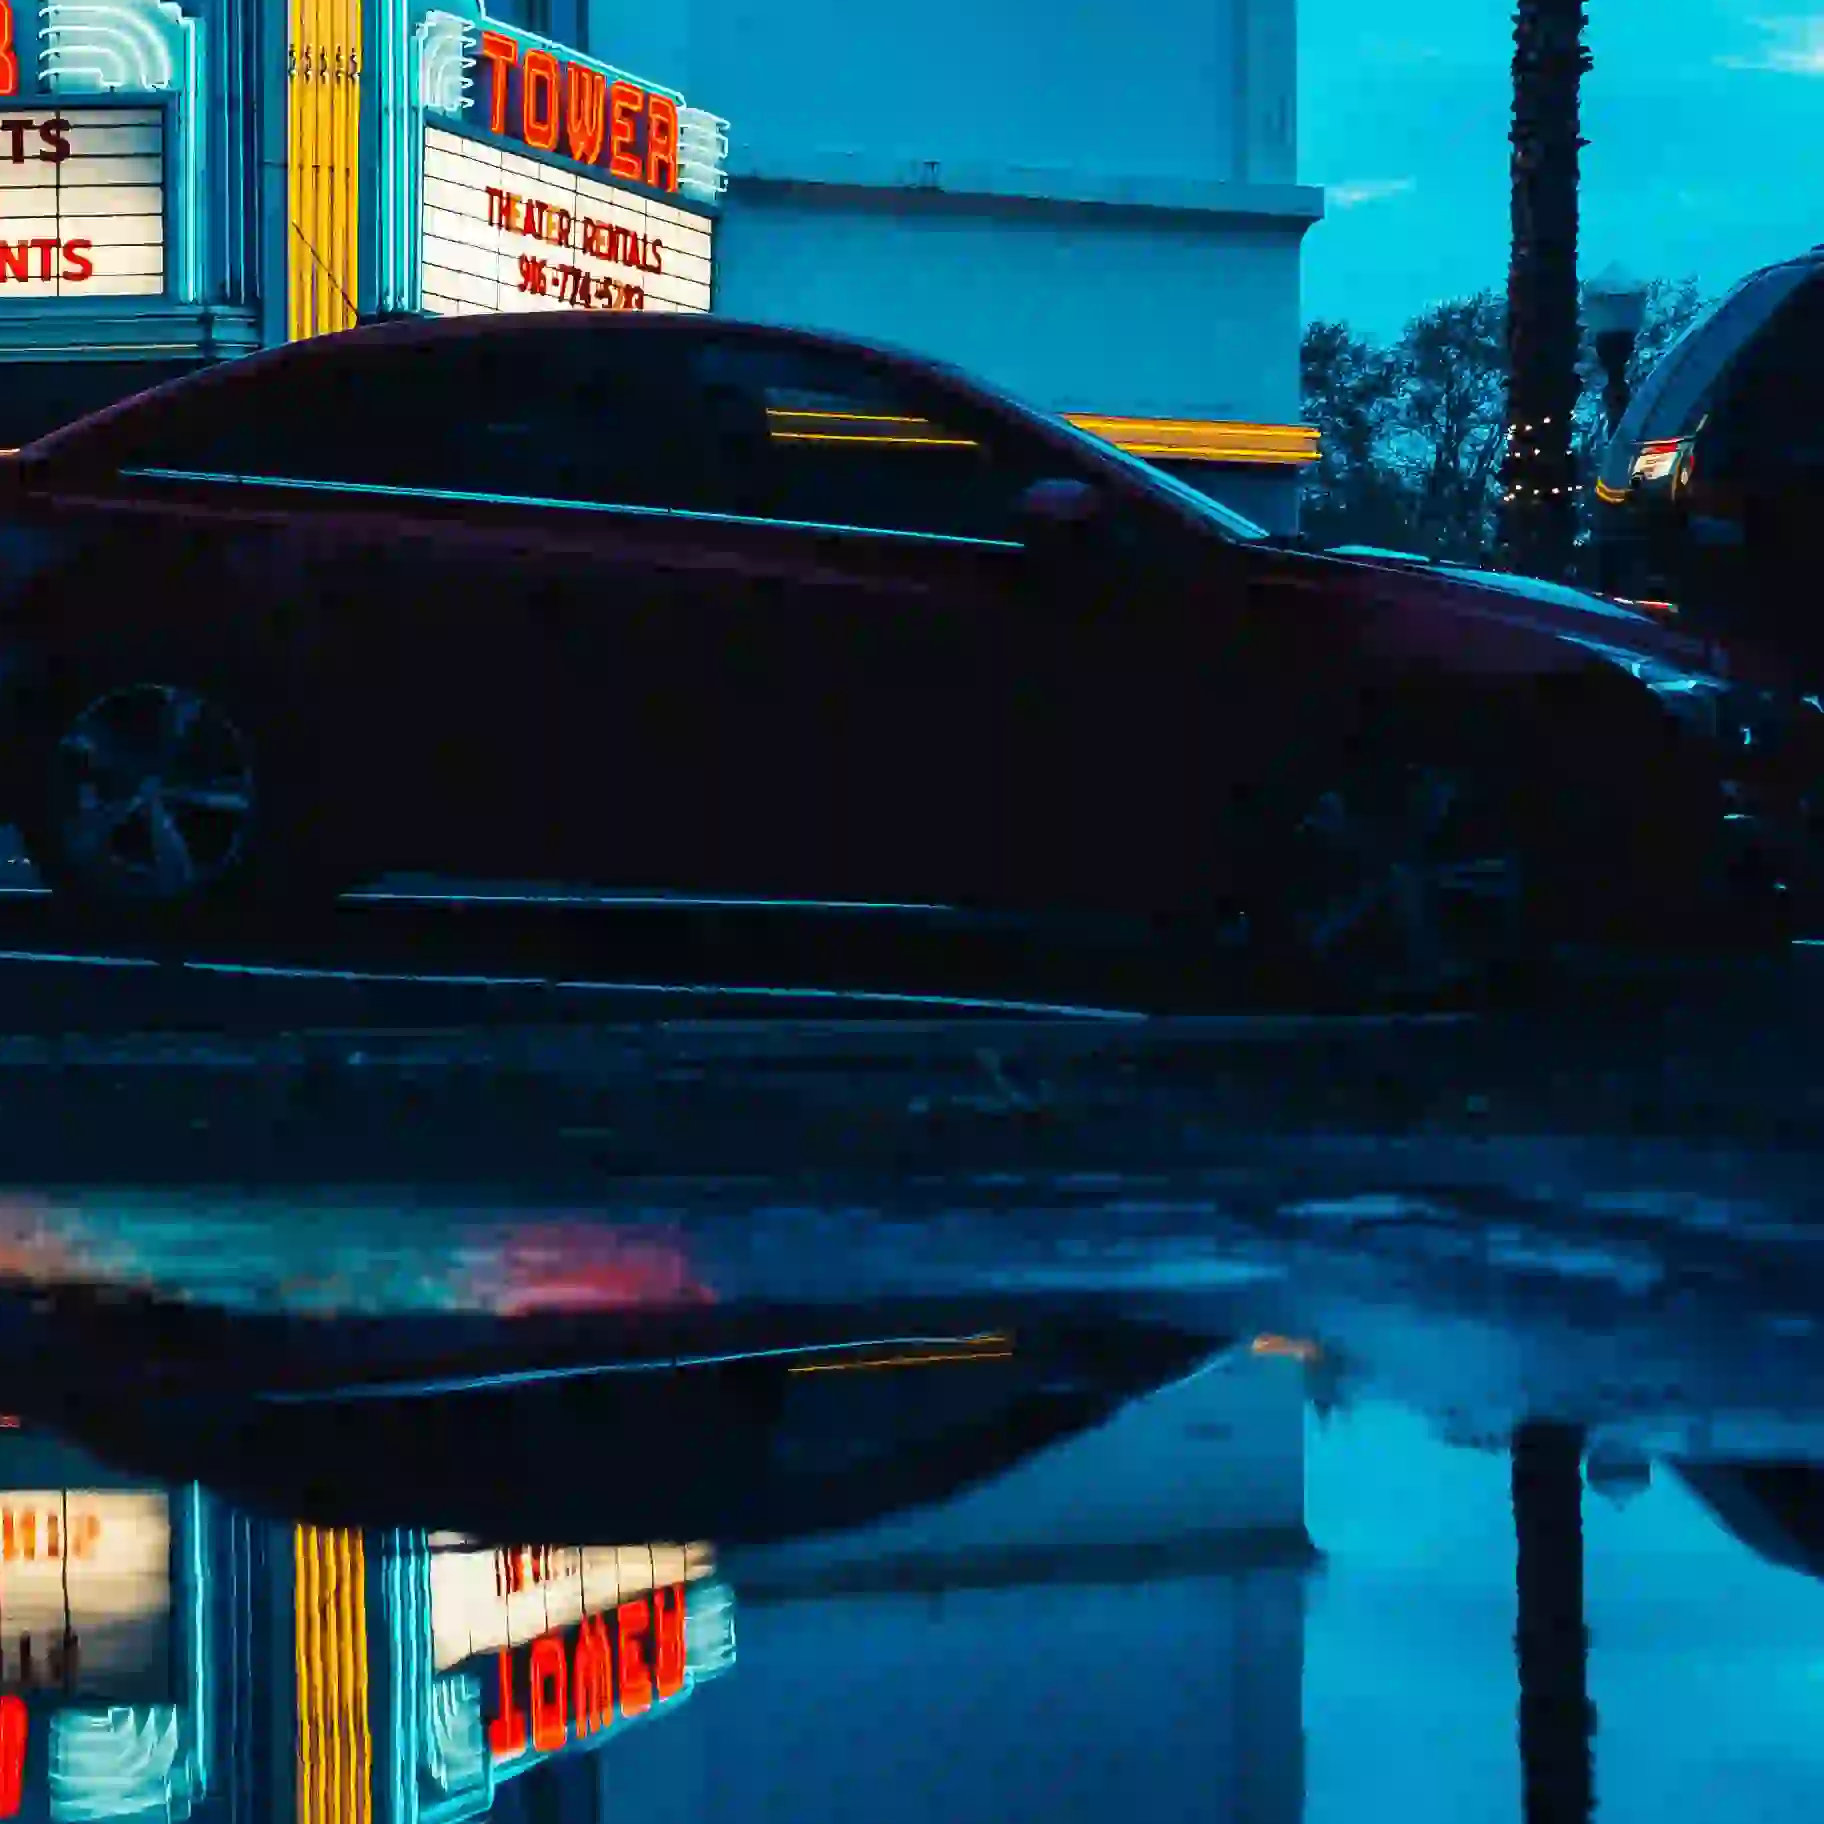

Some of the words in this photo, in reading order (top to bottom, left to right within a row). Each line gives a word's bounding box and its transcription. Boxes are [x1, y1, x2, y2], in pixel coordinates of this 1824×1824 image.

[481, 30, 678, 193] TOWER
[486, 186, 571, 248] THEATER
[582, 216, 663, 274] RENTALS
